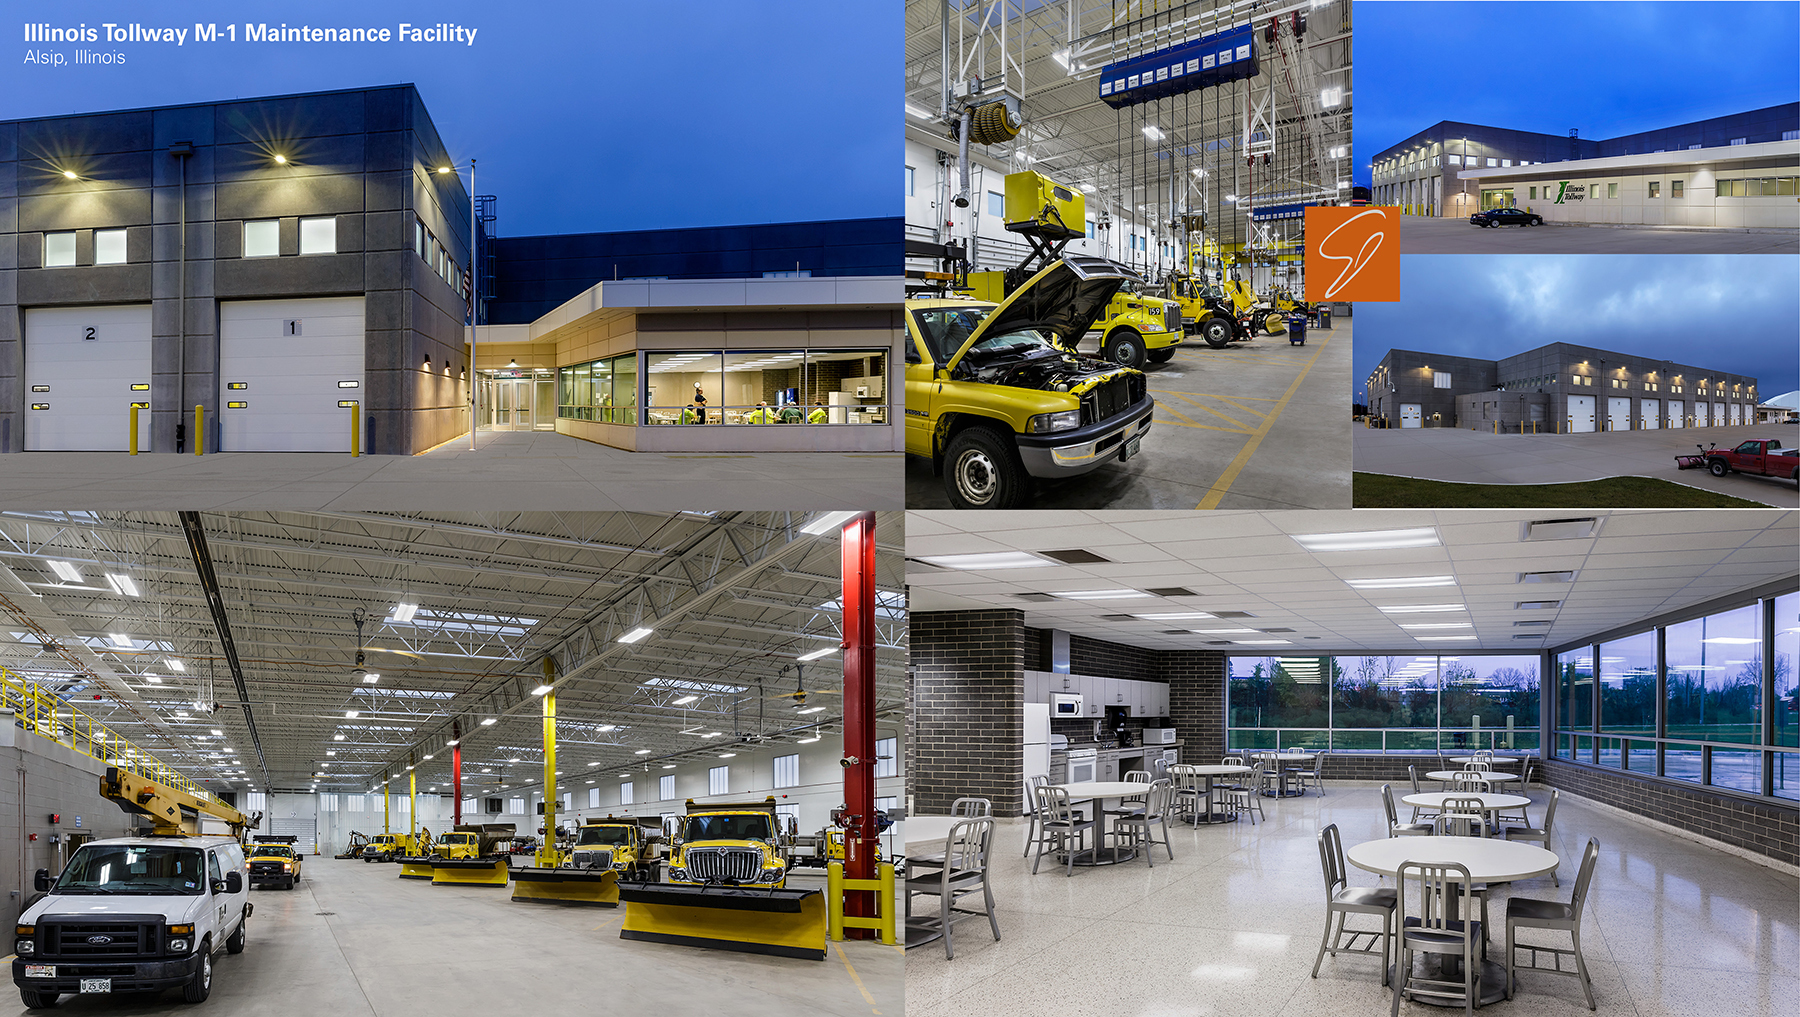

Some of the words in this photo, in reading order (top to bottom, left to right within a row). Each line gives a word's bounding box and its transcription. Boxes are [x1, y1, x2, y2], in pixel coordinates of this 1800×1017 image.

[1566, 184, 1585, 192] Illinois
[1564, 192, 1585, 202] Tollway
[85, 326, 96, 341] 2
